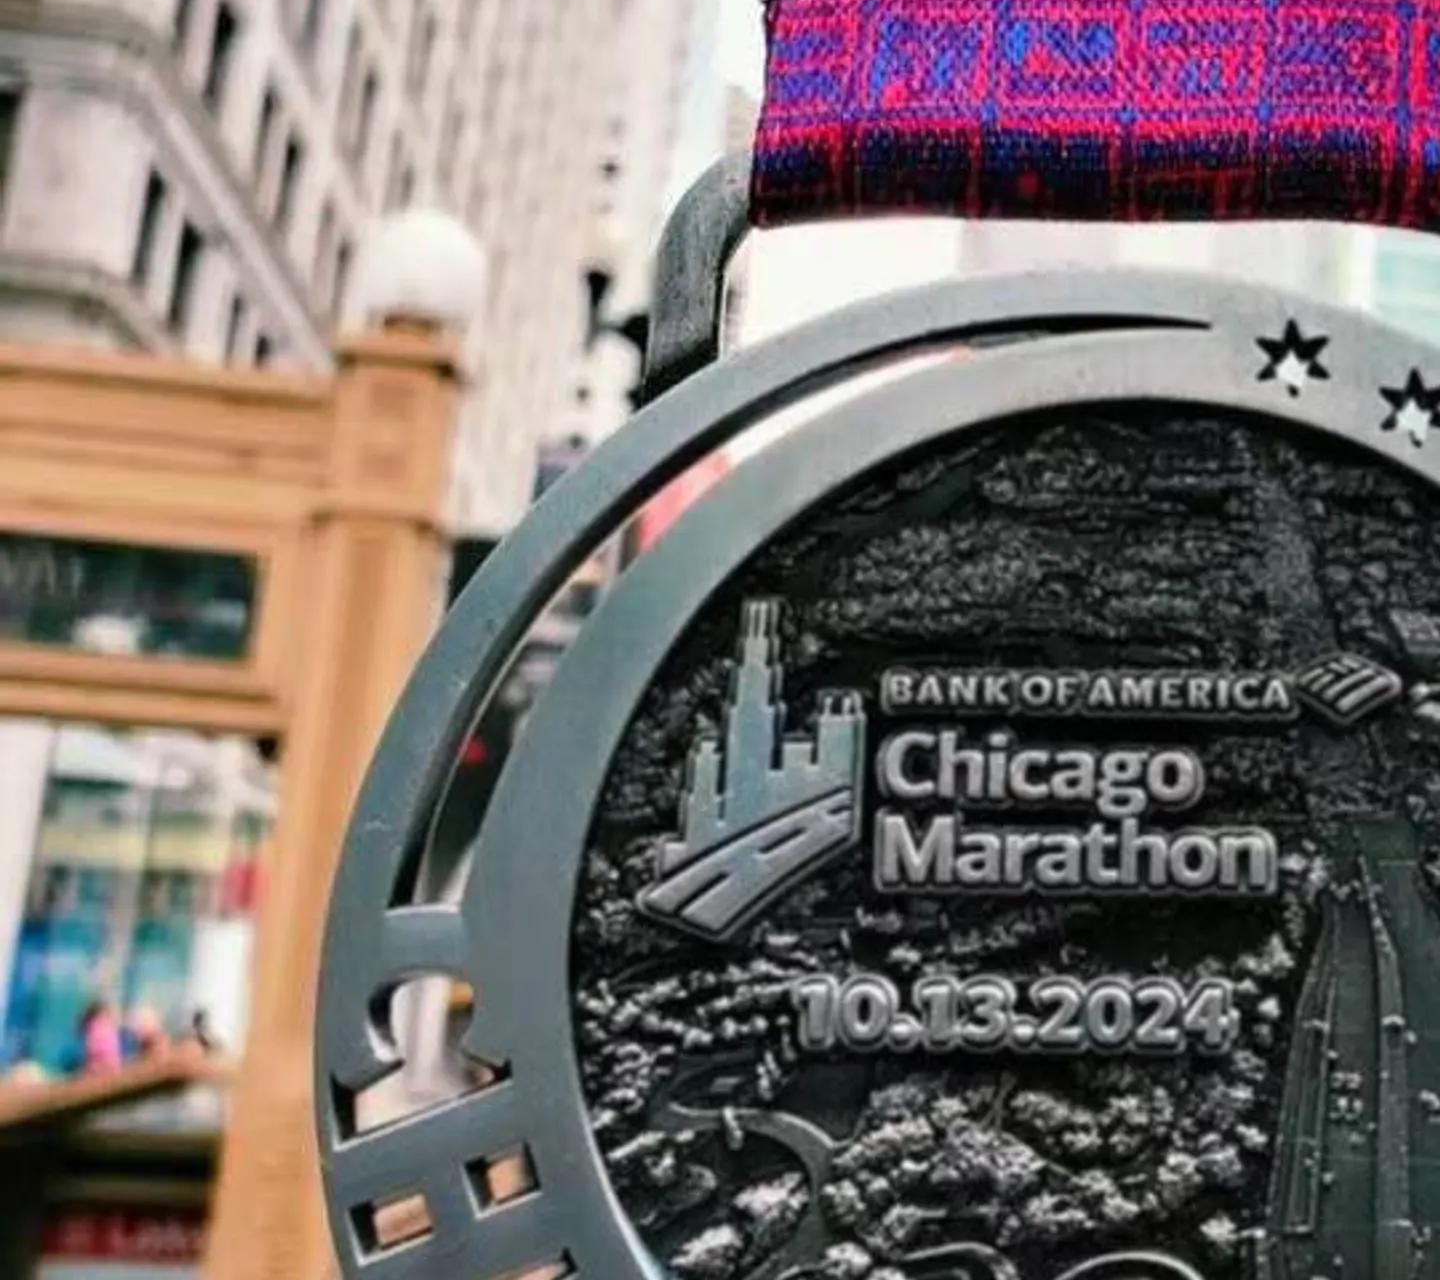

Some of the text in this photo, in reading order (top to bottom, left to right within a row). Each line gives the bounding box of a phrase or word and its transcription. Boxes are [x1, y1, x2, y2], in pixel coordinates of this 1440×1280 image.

[886, 673, 1292, 709] BANK OF AMERICA
[882, 730, 1198, 818] Chicago
[880, 814, 1268, 886] Marathon
[796, 980, 1238, 1047] 10.13.2024
